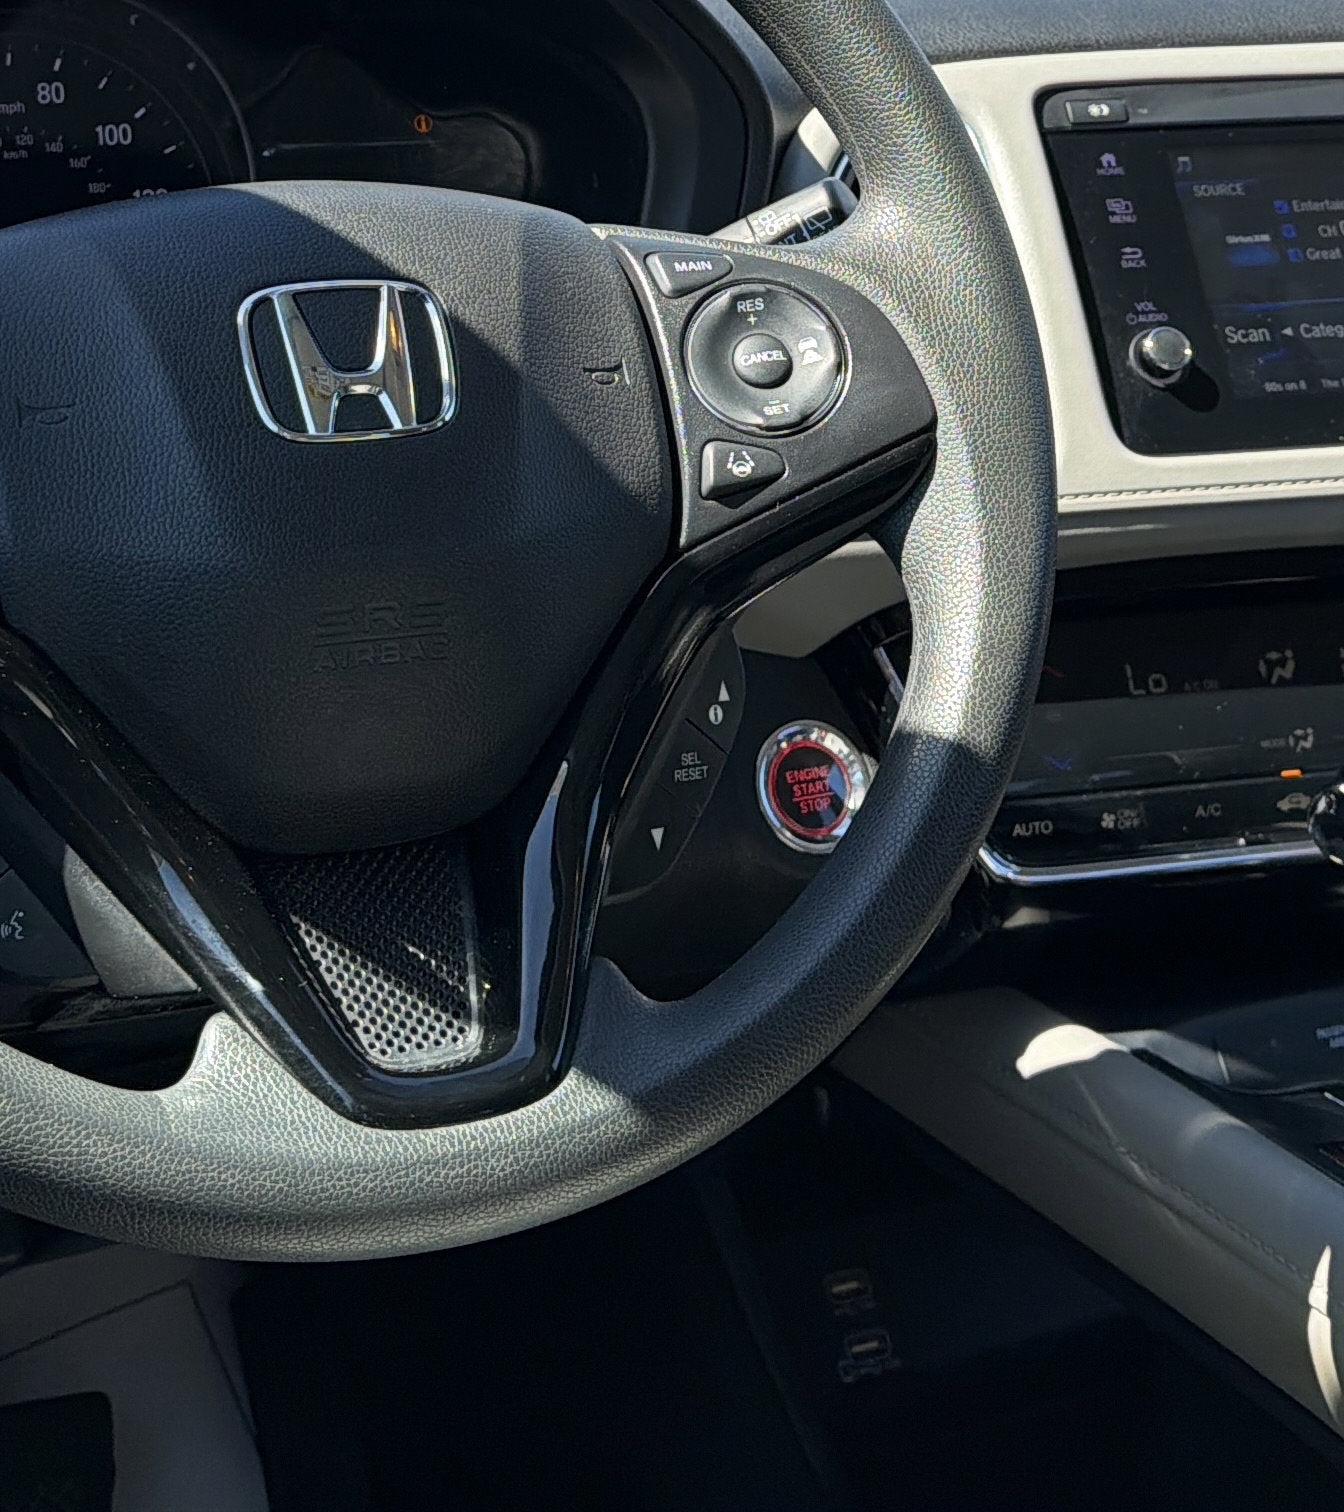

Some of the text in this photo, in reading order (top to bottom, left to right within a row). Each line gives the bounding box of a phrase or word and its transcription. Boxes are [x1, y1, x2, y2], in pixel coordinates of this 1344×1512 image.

[37, 82, 65, 104] 80
[15, 134, 34, 145] 120
[94, 123, 132, 146] 100
[44, 142, 63, 152] 140
[2, 149, 28, 160] km/h
[68, 156, 88, 168] 160
[1096, 166, 1125, 176] HOME
[1192, 183, 1246, 198] SOURCE
[1108, 213, 1137, 224] MENU
[1317, 224, 1337, 237] CH
[1306, 247, 1341, 261] Great
[674, 259, 713, 273] MAIN
[1120, 257, 1147, 269] BACK
[736, 298, 765, 312] RES
[1133, 300, 1158, 312] VOL
[1137, 312, 1168, 322] AUDIO
[1223, 326, 1271, 344] Scan
[740, 350, 788, 366] CANCEL
[763, 403, 791, 417] SET
[312, 639, 451, 674] AIRBAG
[681, 752, 702, 766] SEL
[674, 765, 708, 783] RESET
[786, 765, 830, 784] ENGINE
[792, 780, 831, 796] START
[799, 798, 831, 814] STOP
[1195, 803, 1222, 819] A/C
[1012, 820, 1054, 837] AUTO
[1117, 818, 1141, 830] OFF
